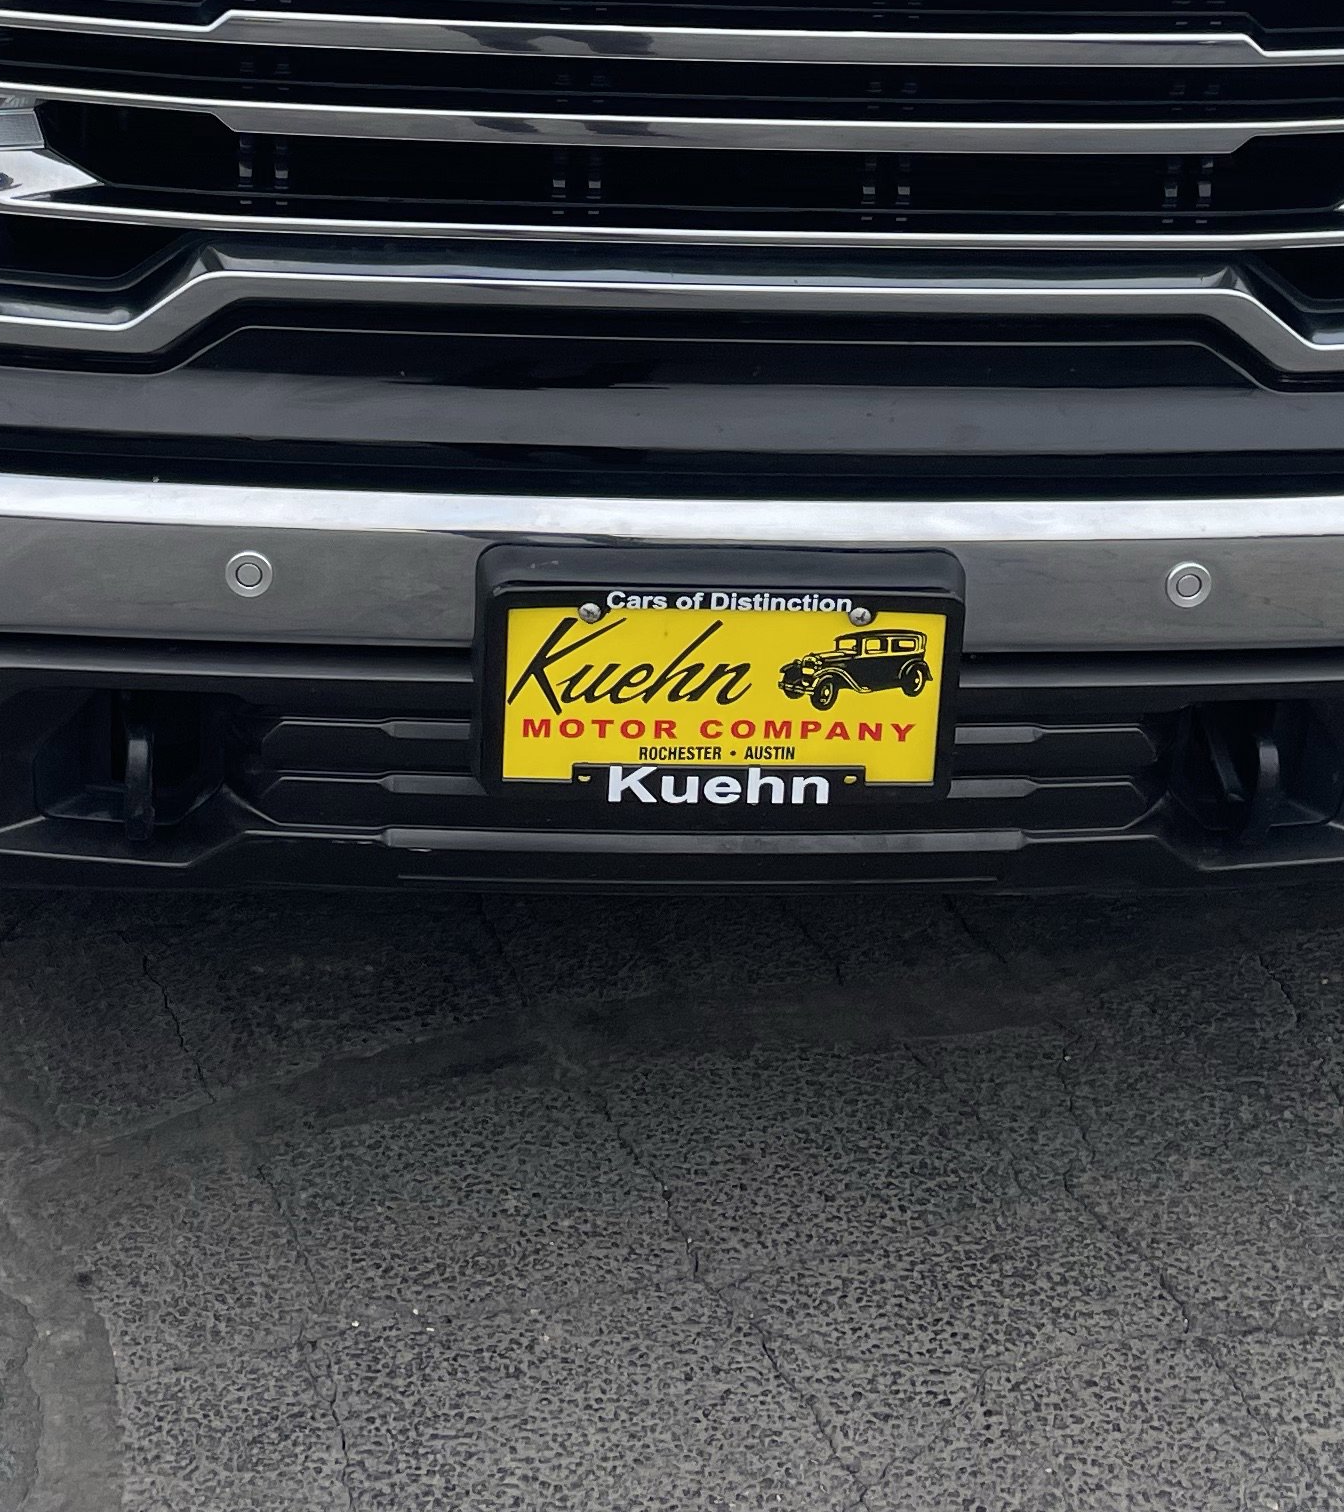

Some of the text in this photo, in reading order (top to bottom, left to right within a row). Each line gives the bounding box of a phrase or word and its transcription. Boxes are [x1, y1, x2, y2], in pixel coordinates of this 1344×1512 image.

[606, 591, 852, 614] Cars of Distinction
[507, 616, 753, 716] Kuehn
[522, 718, 916, 742] MOTOR COMPANY
[638, 746, 795, 761] ROCHESTER AUSTIN
[606, 765, 830, 805] Kuehn
